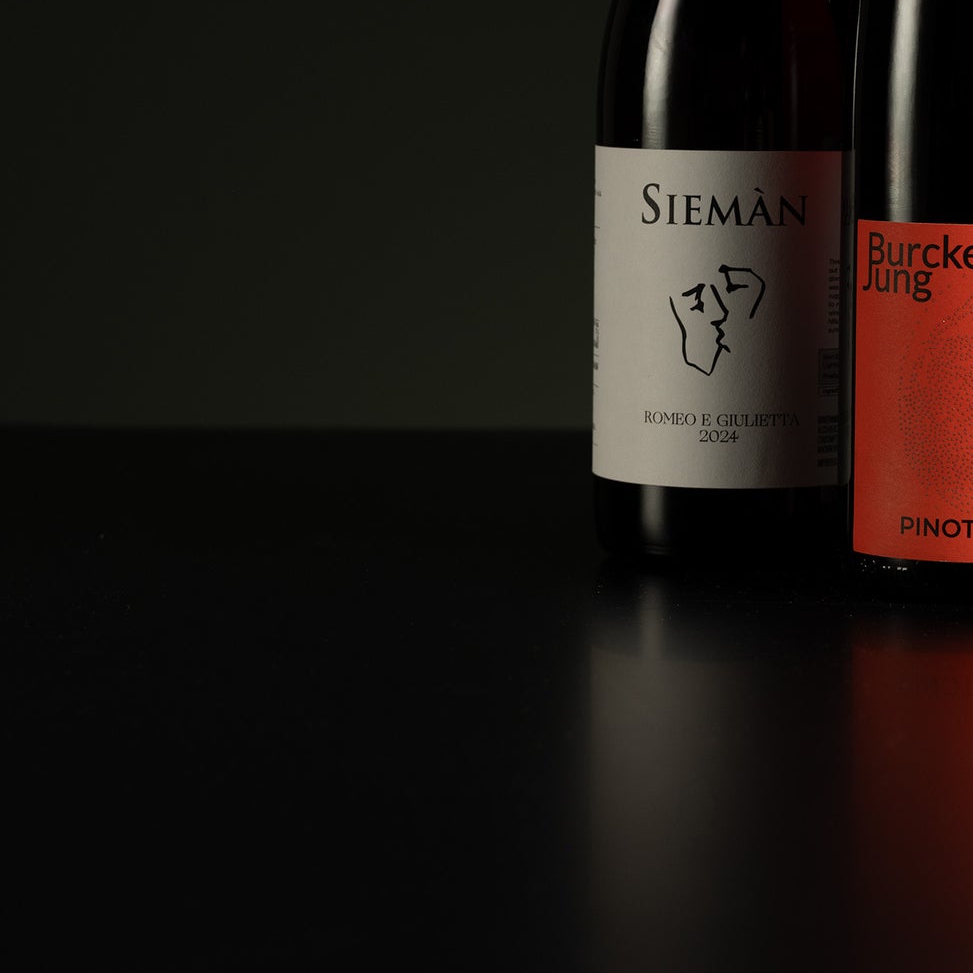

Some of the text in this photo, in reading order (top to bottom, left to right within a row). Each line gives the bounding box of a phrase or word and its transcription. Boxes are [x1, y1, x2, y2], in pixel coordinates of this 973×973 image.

[641, 183, 808, 226] SIEMÀN
[863, 262, 933, 303] Jung
[644, 410, 801, 427] ROMEO E GIULIETTA
[699, 430, 739, 443] 2024
